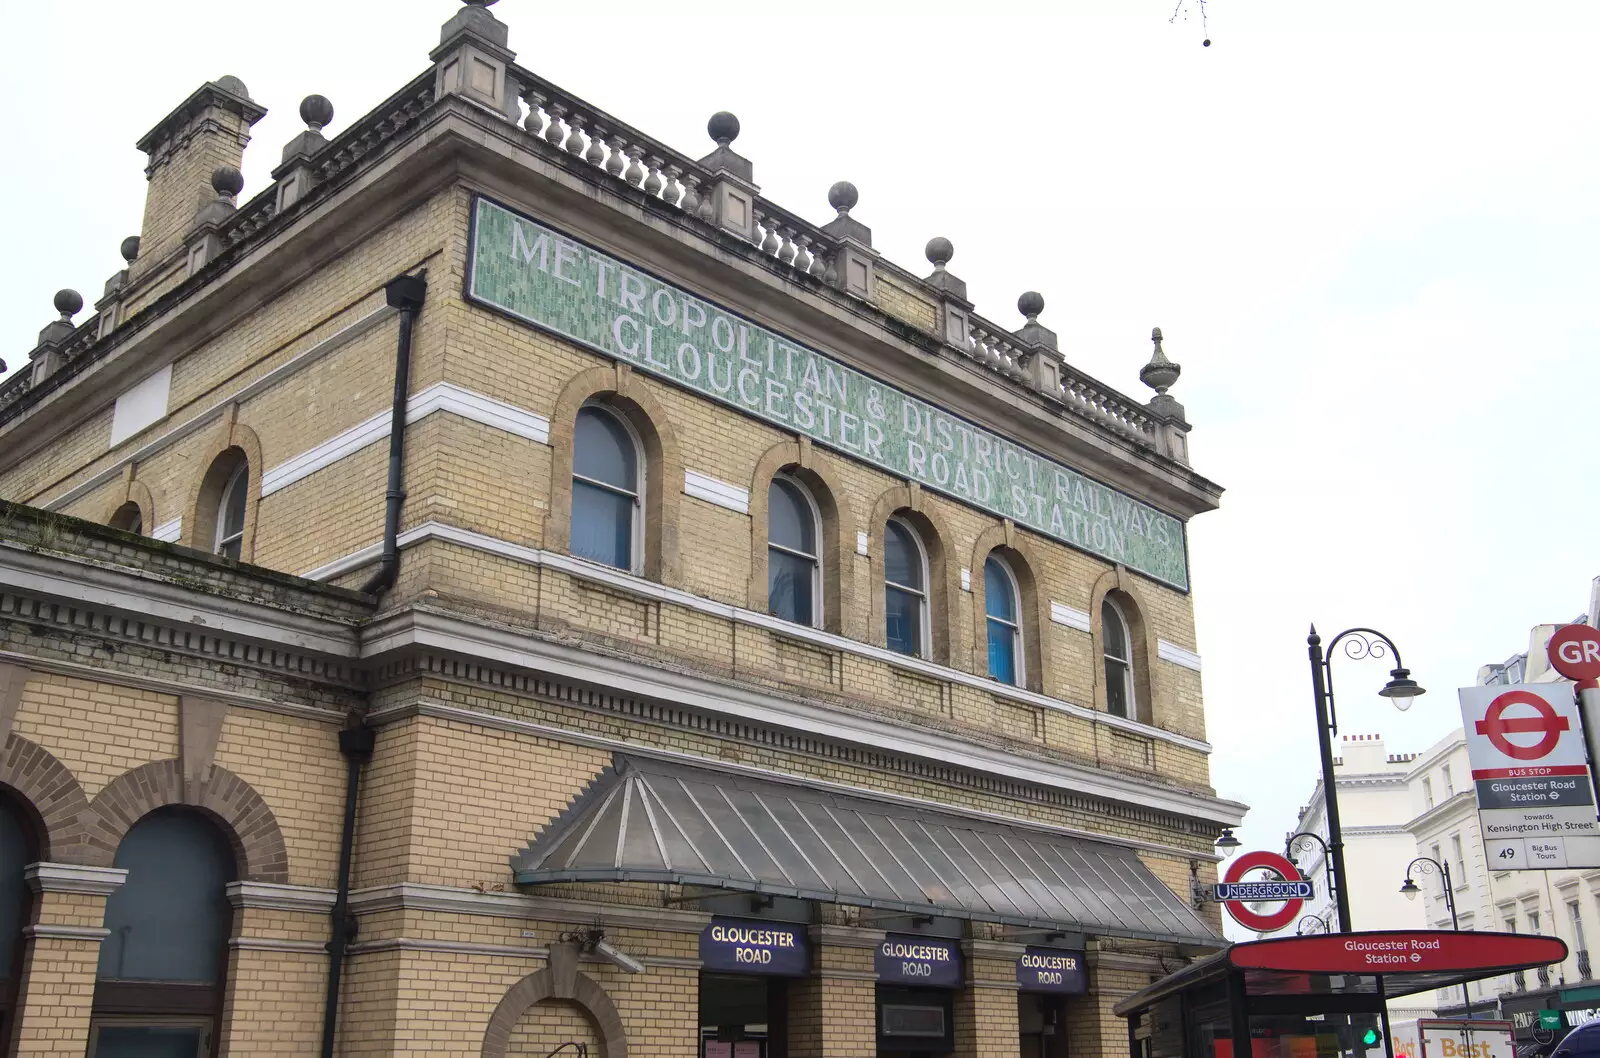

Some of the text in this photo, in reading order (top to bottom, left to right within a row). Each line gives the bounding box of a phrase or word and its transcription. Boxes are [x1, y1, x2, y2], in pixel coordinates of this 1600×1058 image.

[508, 221, 1170, 546] METROPOLITAN & DISTRICT RAILWAYS
[613, 314, 1125, 561] GLOUCESTER ROAD STATION
[1491, 780, 1576, 792] Gloucester Road
[1510, 793, 1547, 802] Station
[1487, 821, 1595, 833] Kensington High Street
[1499, 848, 1515, 859] 49
[1217, 882, 1311, 900] UNDERGROUND
[711, 925, 795, 948] GLOUCESTER
[882, 942, 950, 962] GLOUCESTER
[1344, 939, 1440, 951] Gloucester Road
[735, 947, 772, 965] ROAD
[1021, 954, 1077, 970] GLOUCESTER
[1365, 953, 1407, 964] Station
[902, 961, 932, 977] ROAD
[1037, 971, 1063, 985] ROAD
[1513, 1011, 1534, 1029] PAU
[1440, 1038, 1491, 1058] Best
